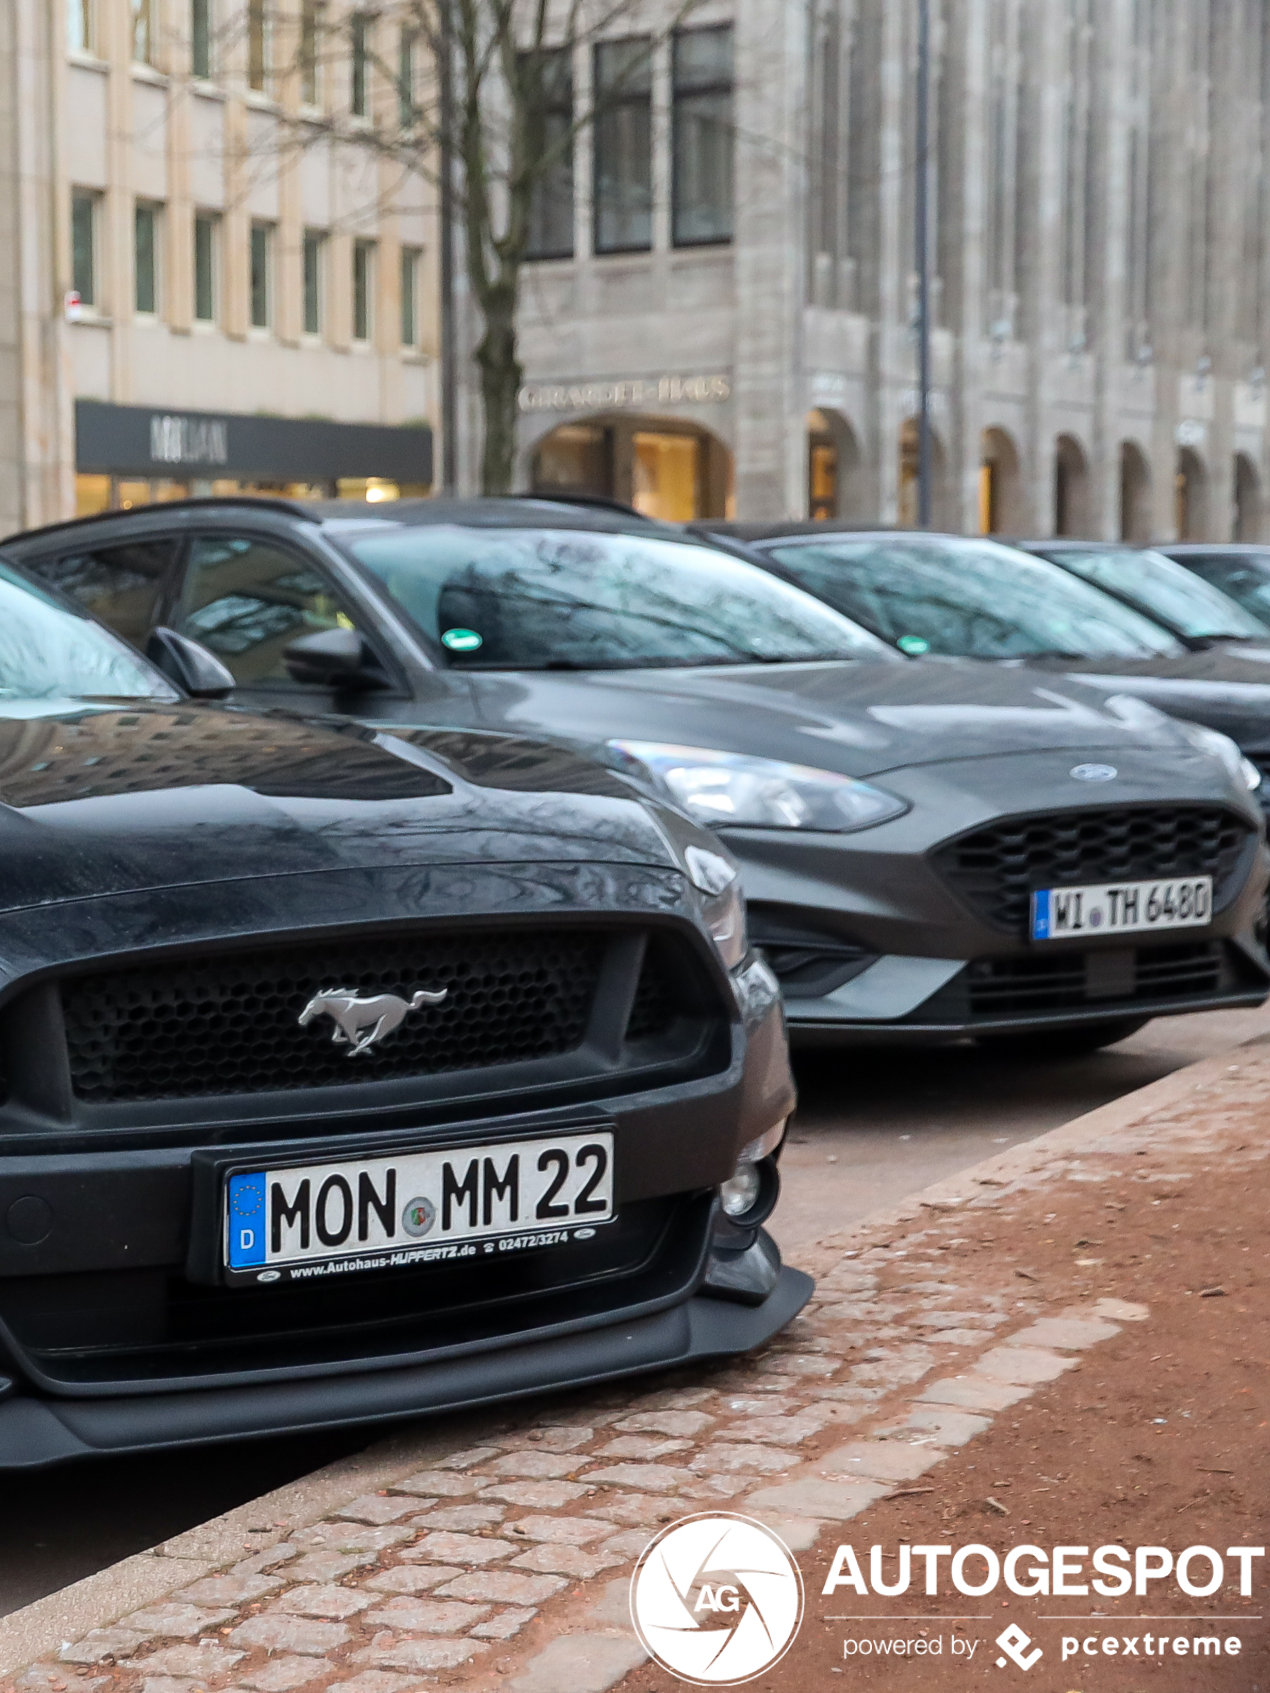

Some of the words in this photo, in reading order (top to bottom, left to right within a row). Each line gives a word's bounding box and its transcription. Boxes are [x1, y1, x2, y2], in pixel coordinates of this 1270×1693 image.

[1106, 887, 1140, 927] TH
[1146, 882, 1205, 922] 6480
[271, 1168, 396, 1253] MON
[442, 1153, 519, 1231] MM
[535, 1143, 607, 1220] 22
[241, 1229, 255, 1250] D
[499, 1231, 569, 1251] 02472/3274
